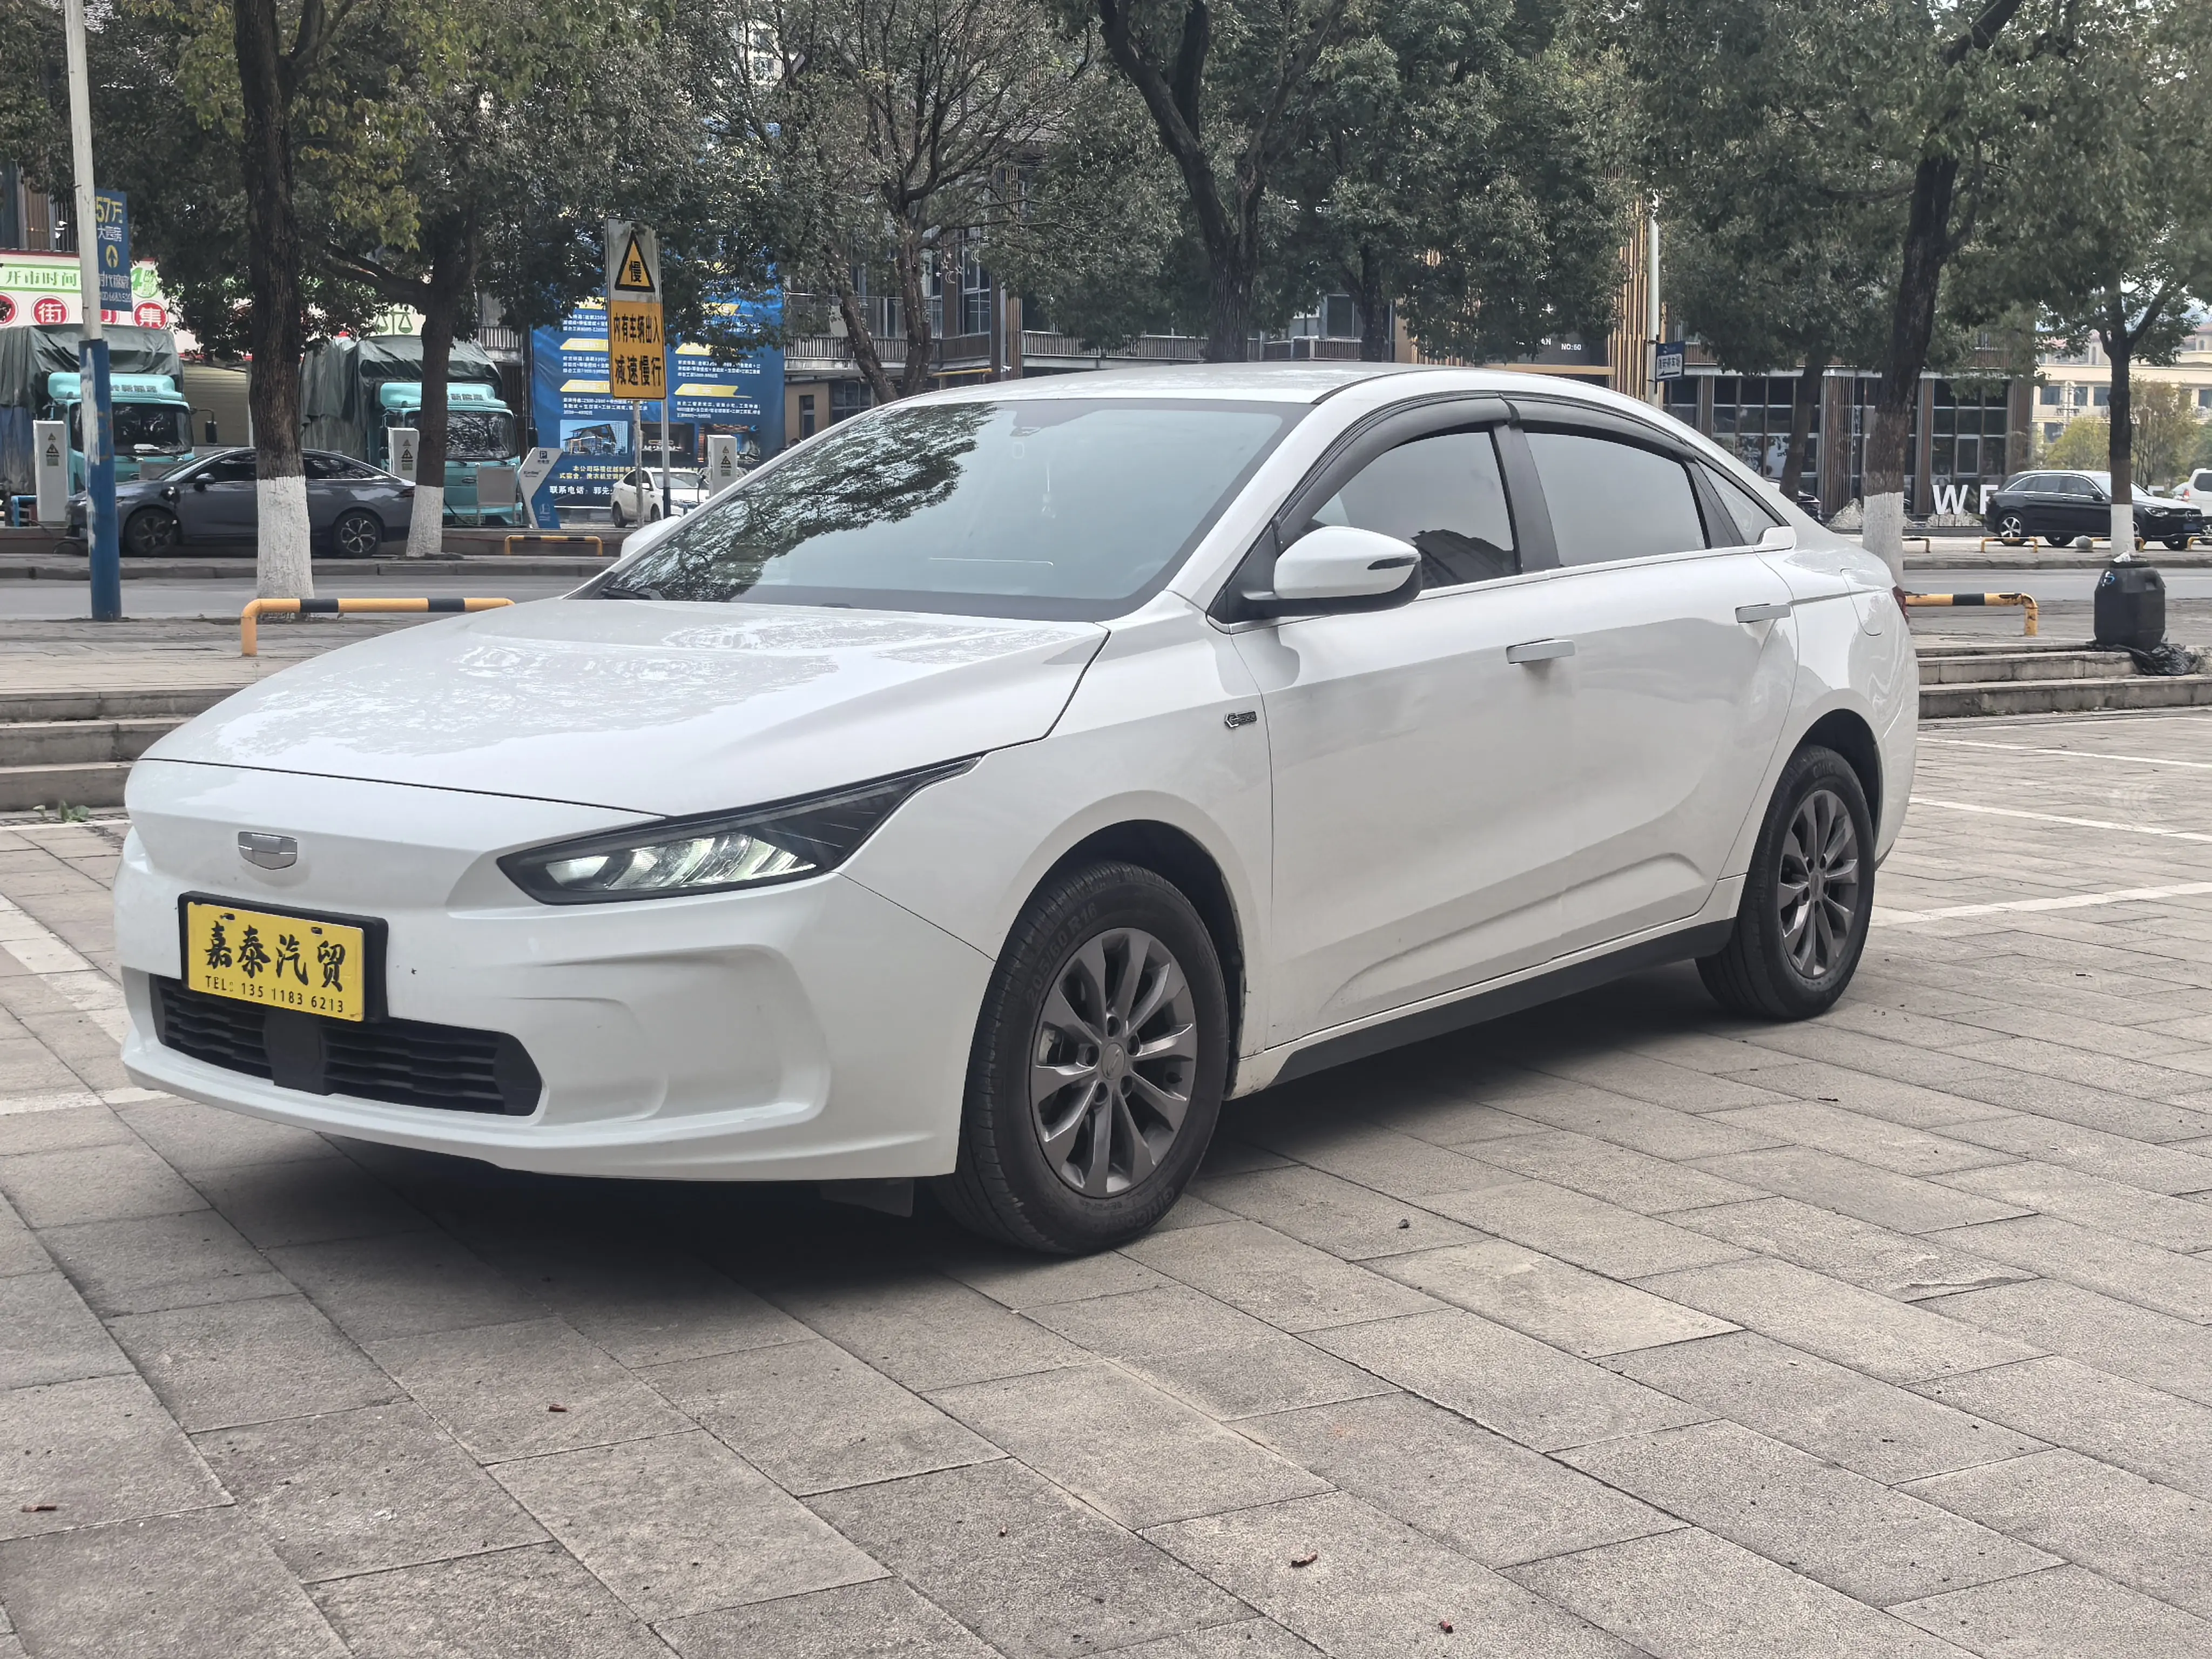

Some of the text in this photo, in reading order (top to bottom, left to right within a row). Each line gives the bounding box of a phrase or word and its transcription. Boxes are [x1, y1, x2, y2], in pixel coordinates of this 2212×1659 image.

[629, 260, 642, 283] 慢
[613, 313, 660, 344] 内有车辆出入
[615, 354, 662, 387] 减速慢行
[204, 920, 346, 993] 嘉泰汽贸
[242, 983, 264, 998] 135
[271, 989, 304, 1005] 1183
[311, 996, 344, 1013] 6213
